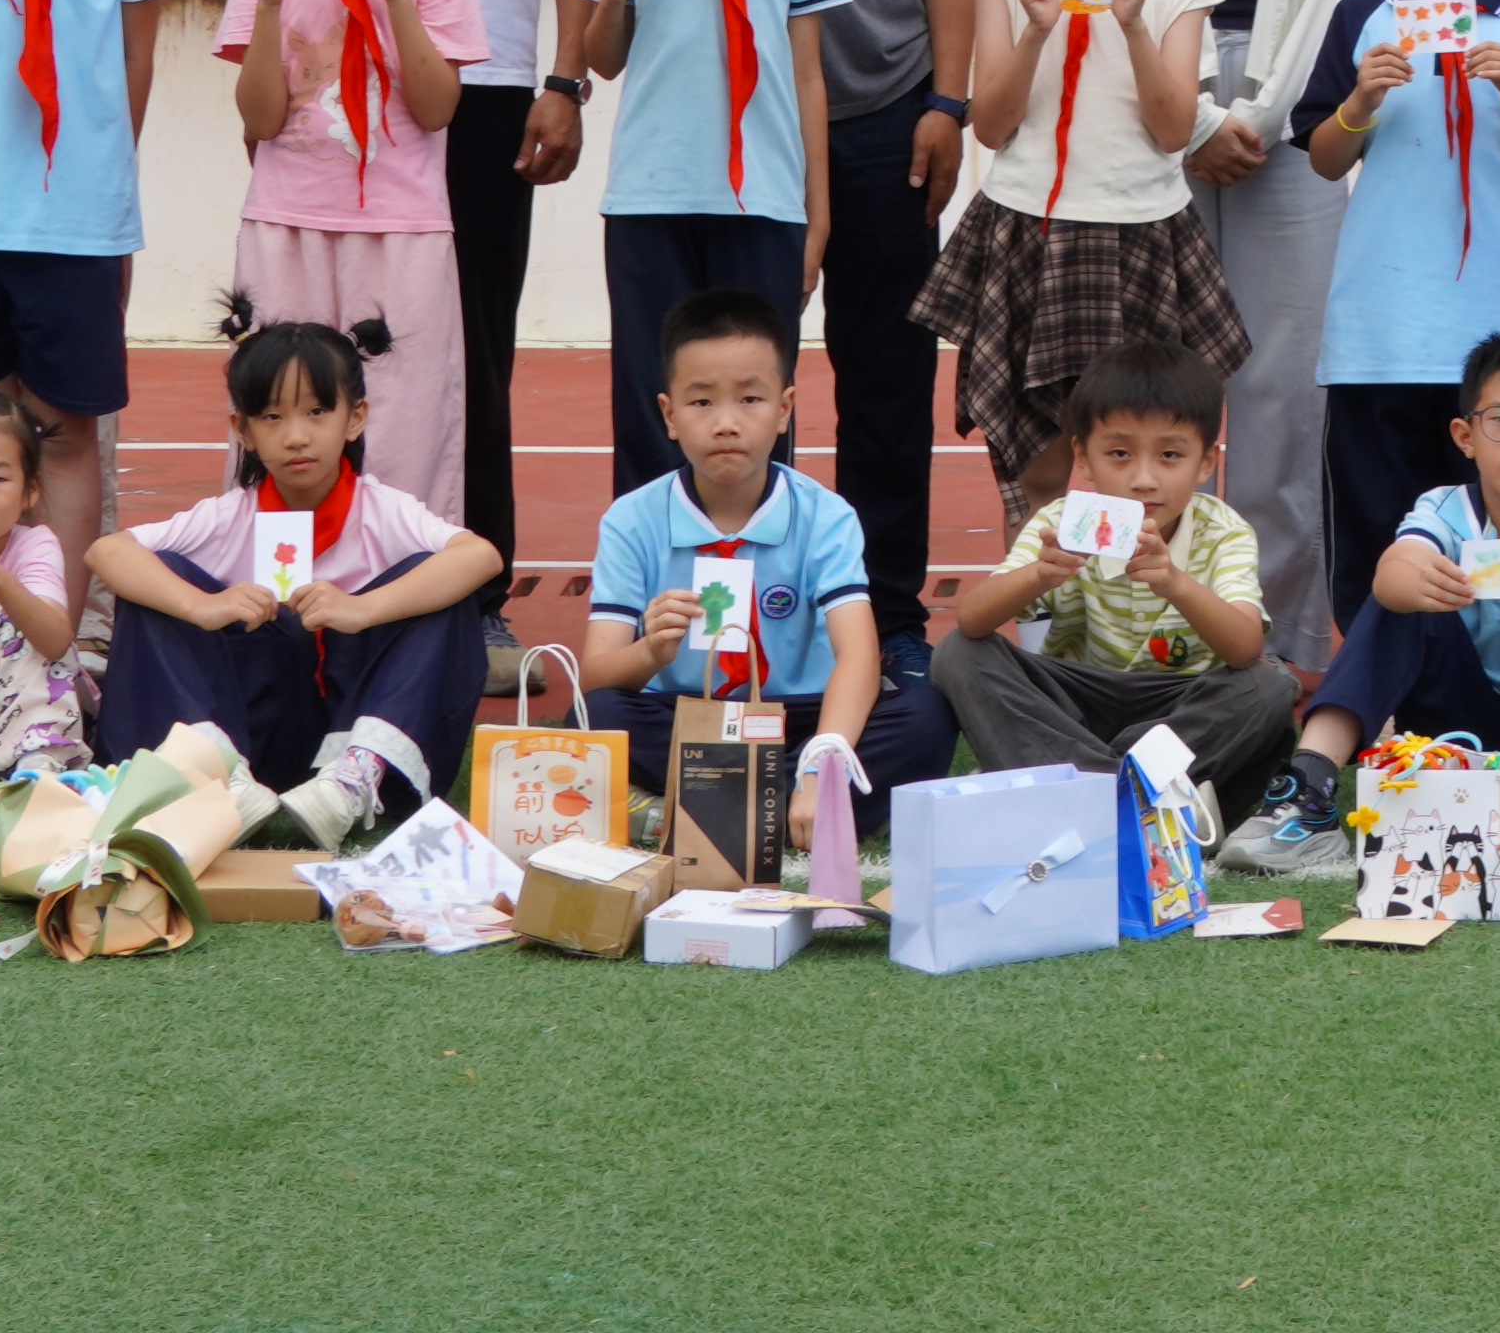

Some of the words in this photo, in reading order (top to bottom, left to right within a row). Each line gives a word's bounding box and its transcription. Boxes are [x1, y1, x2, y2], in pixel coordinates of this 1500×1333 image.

[683, 749, 704, 760] UNI
[764, 749, 778, 779] UNI
[762, 786, 777, 866] COMPLEX
